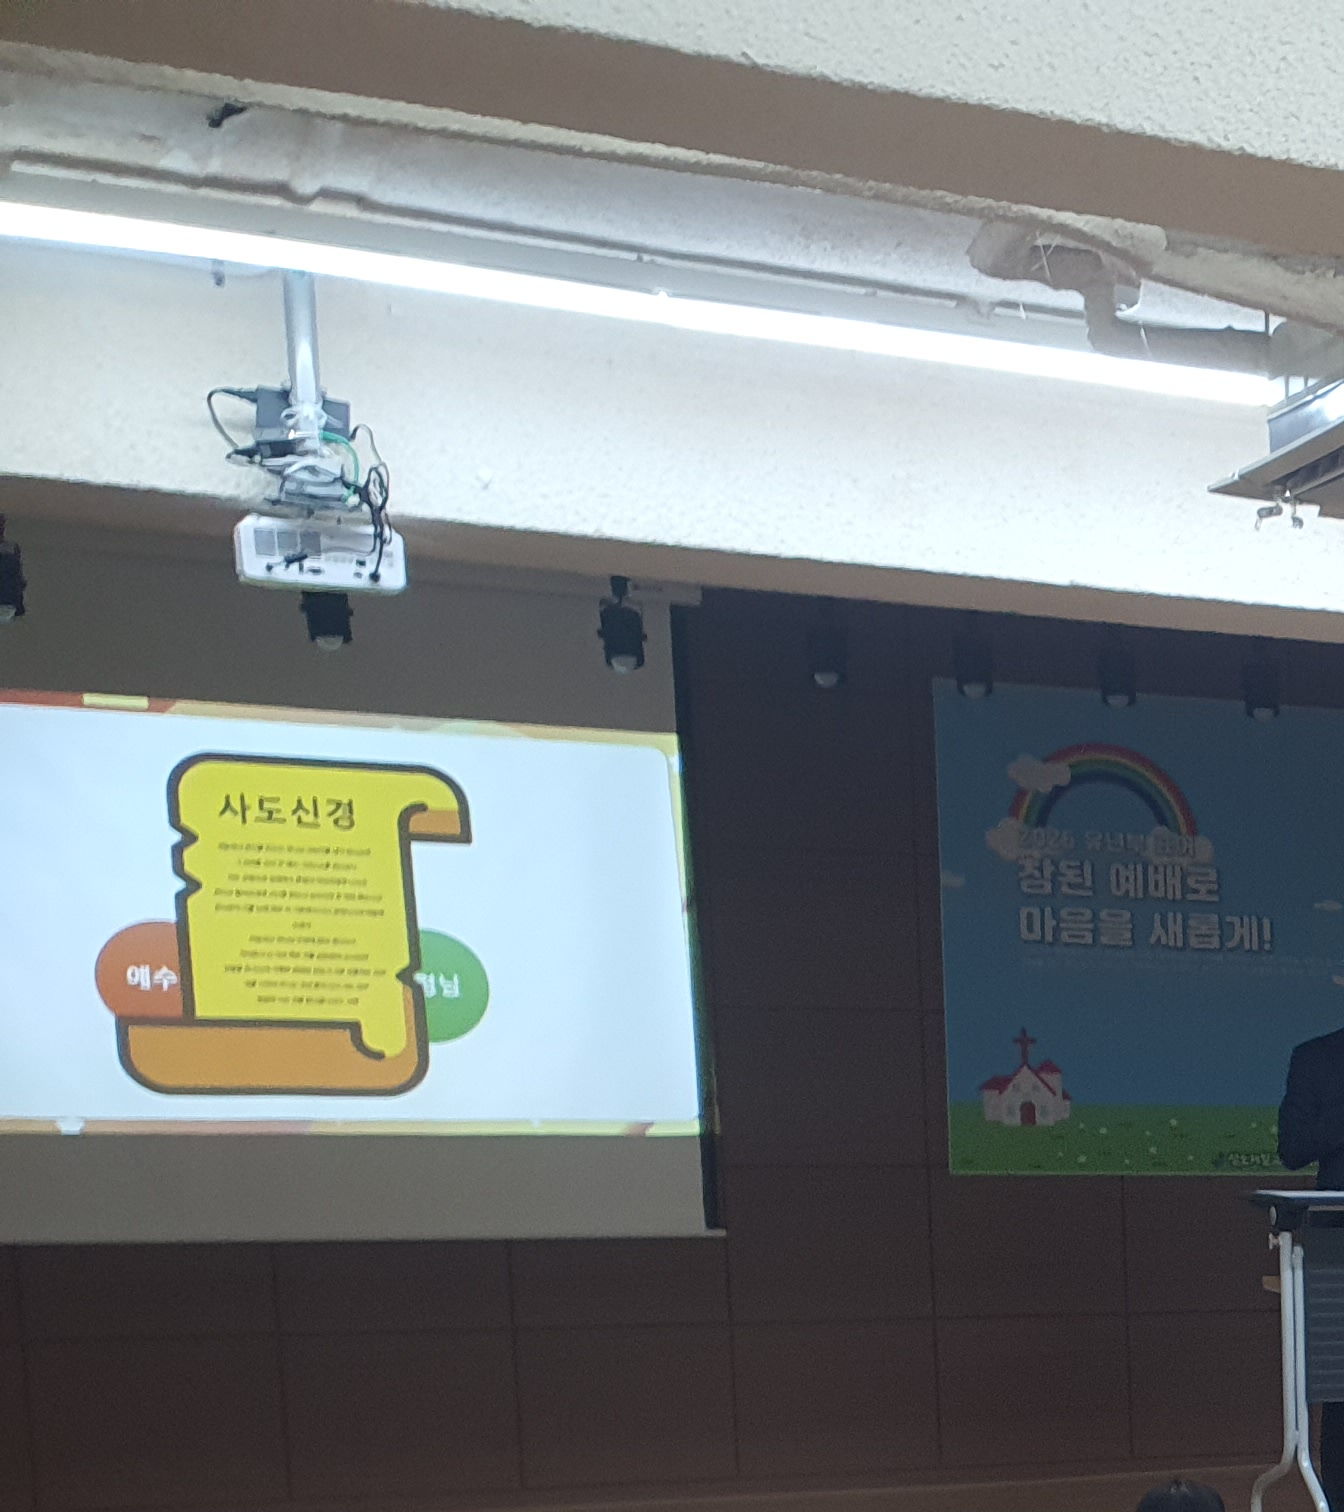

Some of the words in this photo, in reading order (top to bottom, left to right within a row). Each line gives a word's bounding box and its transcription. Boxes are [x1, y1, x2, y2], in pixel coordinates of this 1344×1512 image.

[218, 792, 356, 831] 사도신경
[1018, 853, 1095, 898] 참된
[1109, 860, 1221, 903] 예배로
[1018, 904, 1135, 949] 마음을
[1149, 910, 1275, 954] 새롭게!
